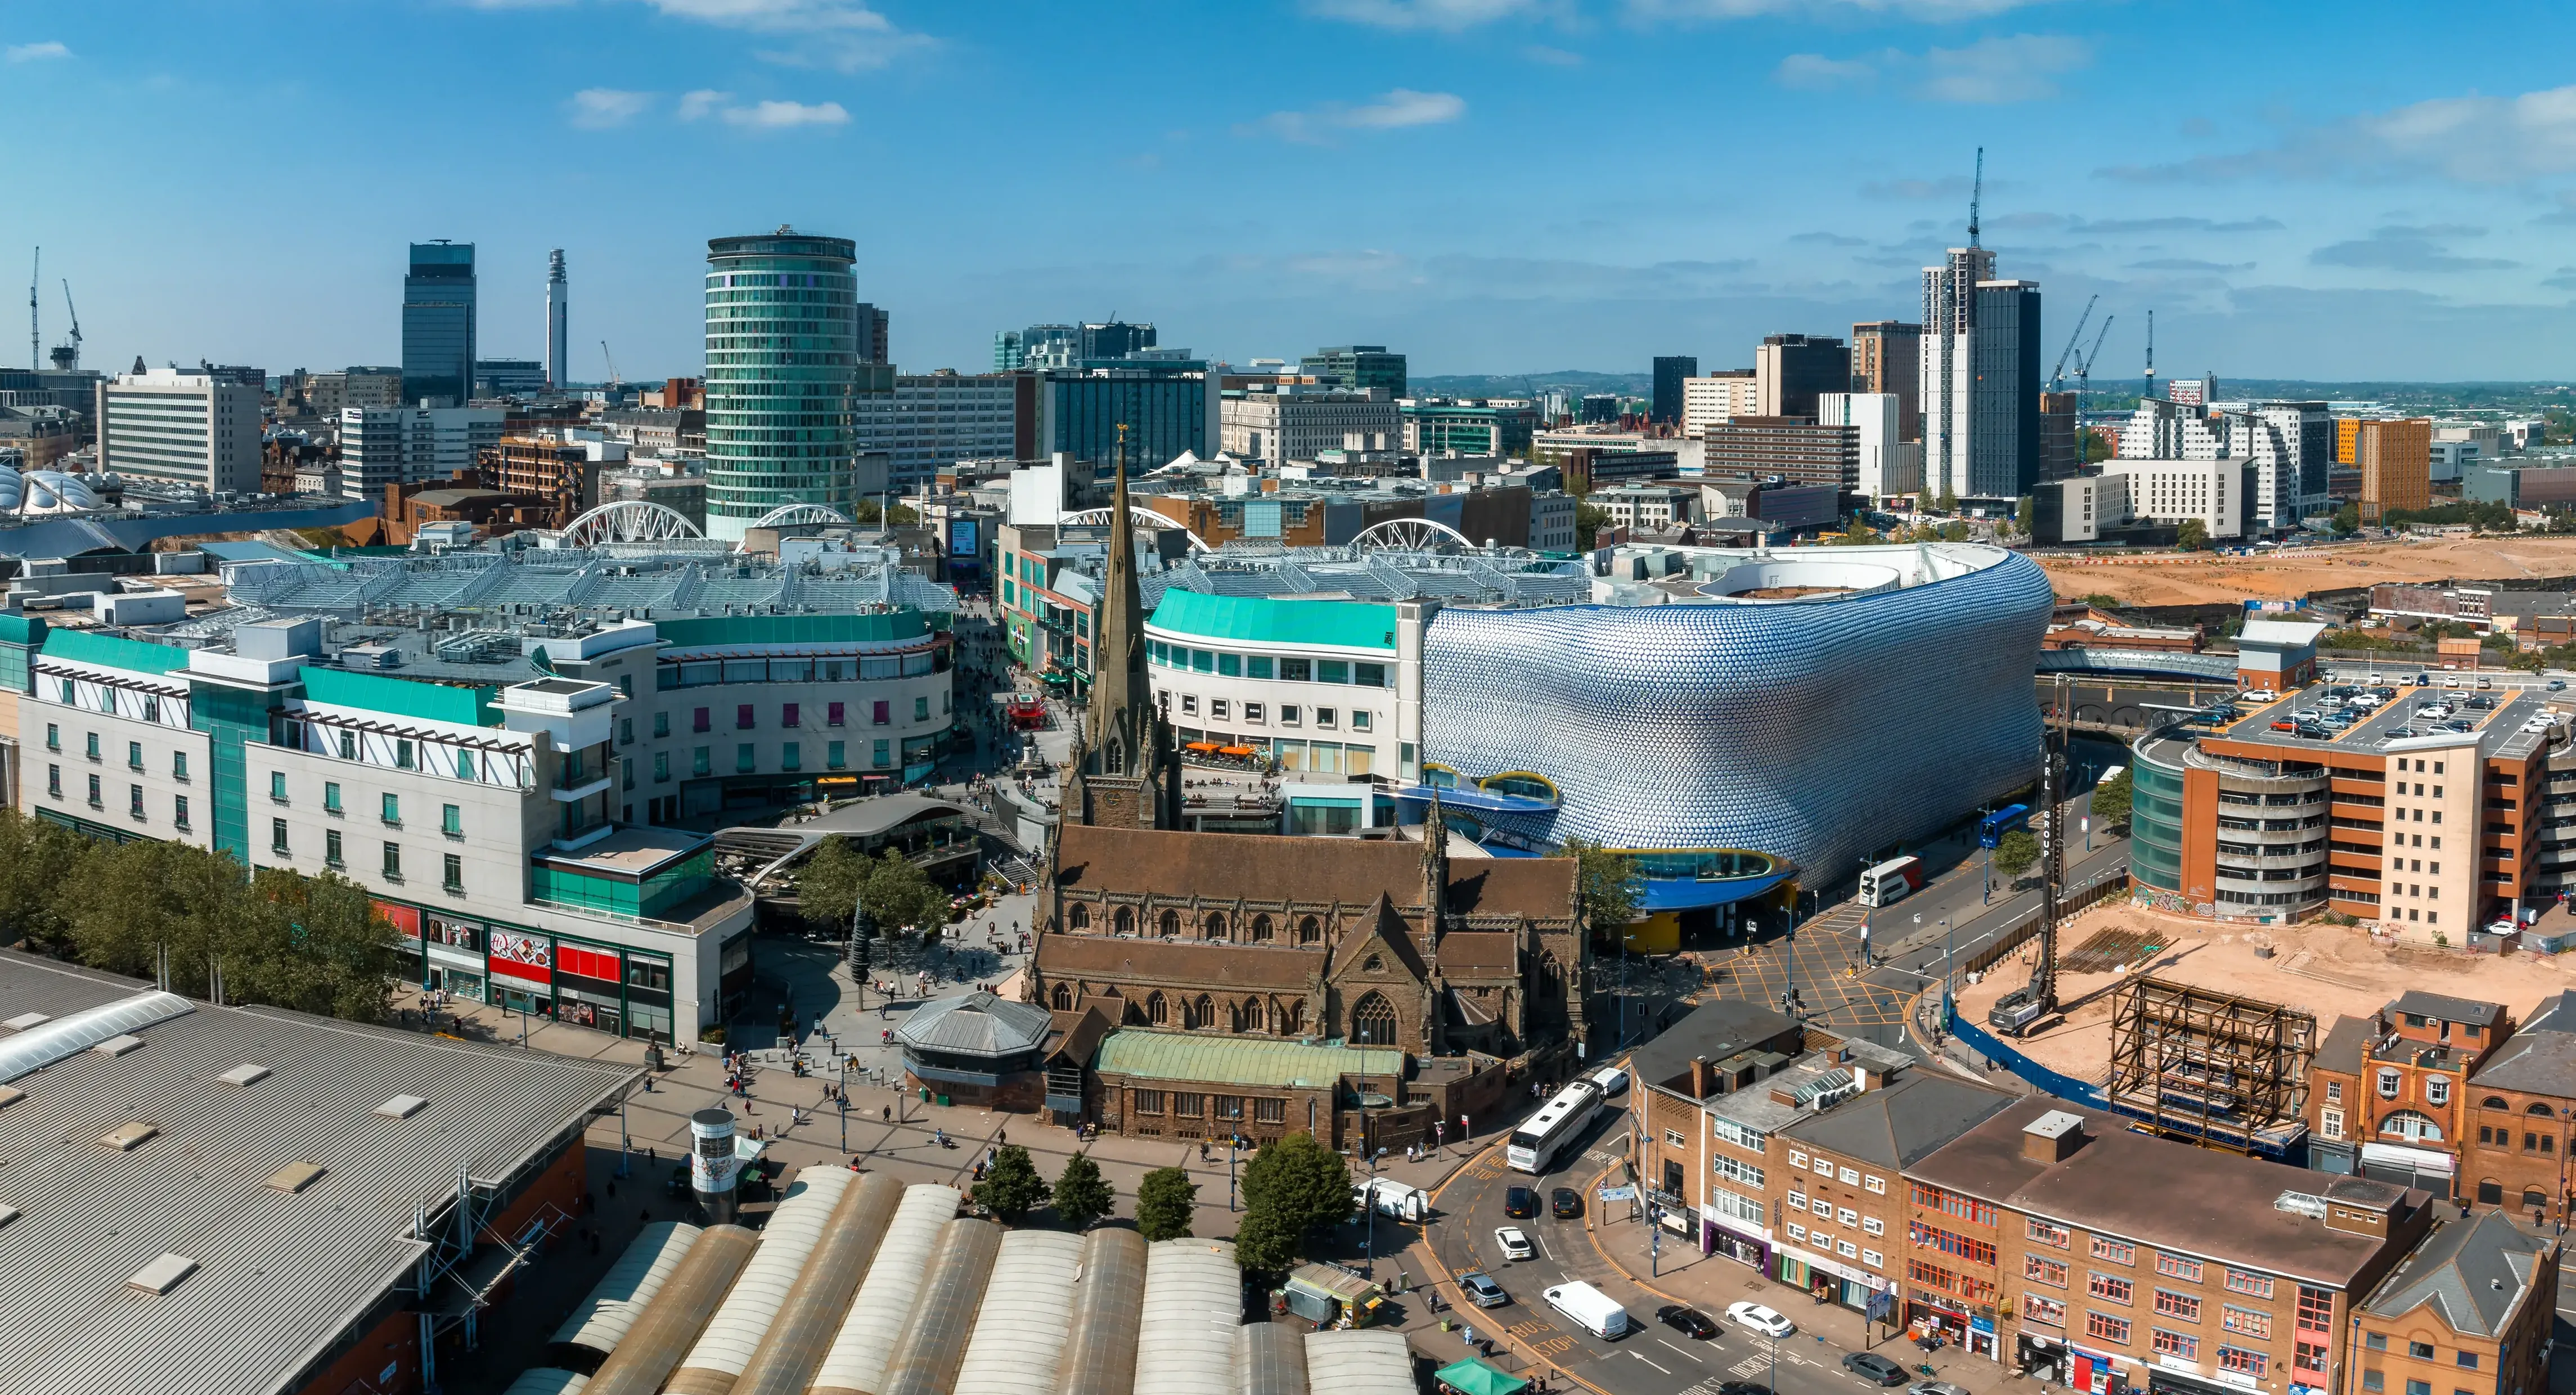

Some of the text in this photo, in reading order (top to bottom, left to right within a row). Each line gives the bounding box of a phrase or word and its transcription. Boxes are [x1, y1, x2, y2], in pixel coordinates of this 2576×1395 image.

[2024, 1009, 2036, 1019] GROUP
[1484, 1155, 1508, 1169] BUS
[1466, 1167, 1497, 1180] STOP
[1509, 1320, 1549, 1338] BUS
[1532, 1336, 1571, 1357] STOP
[1748, 1339, 1780, 1354] LOADING
[1727, 1352, 1781, 1379] DIGBETH
[1787, 1356, 1808, 1366] ONLY
